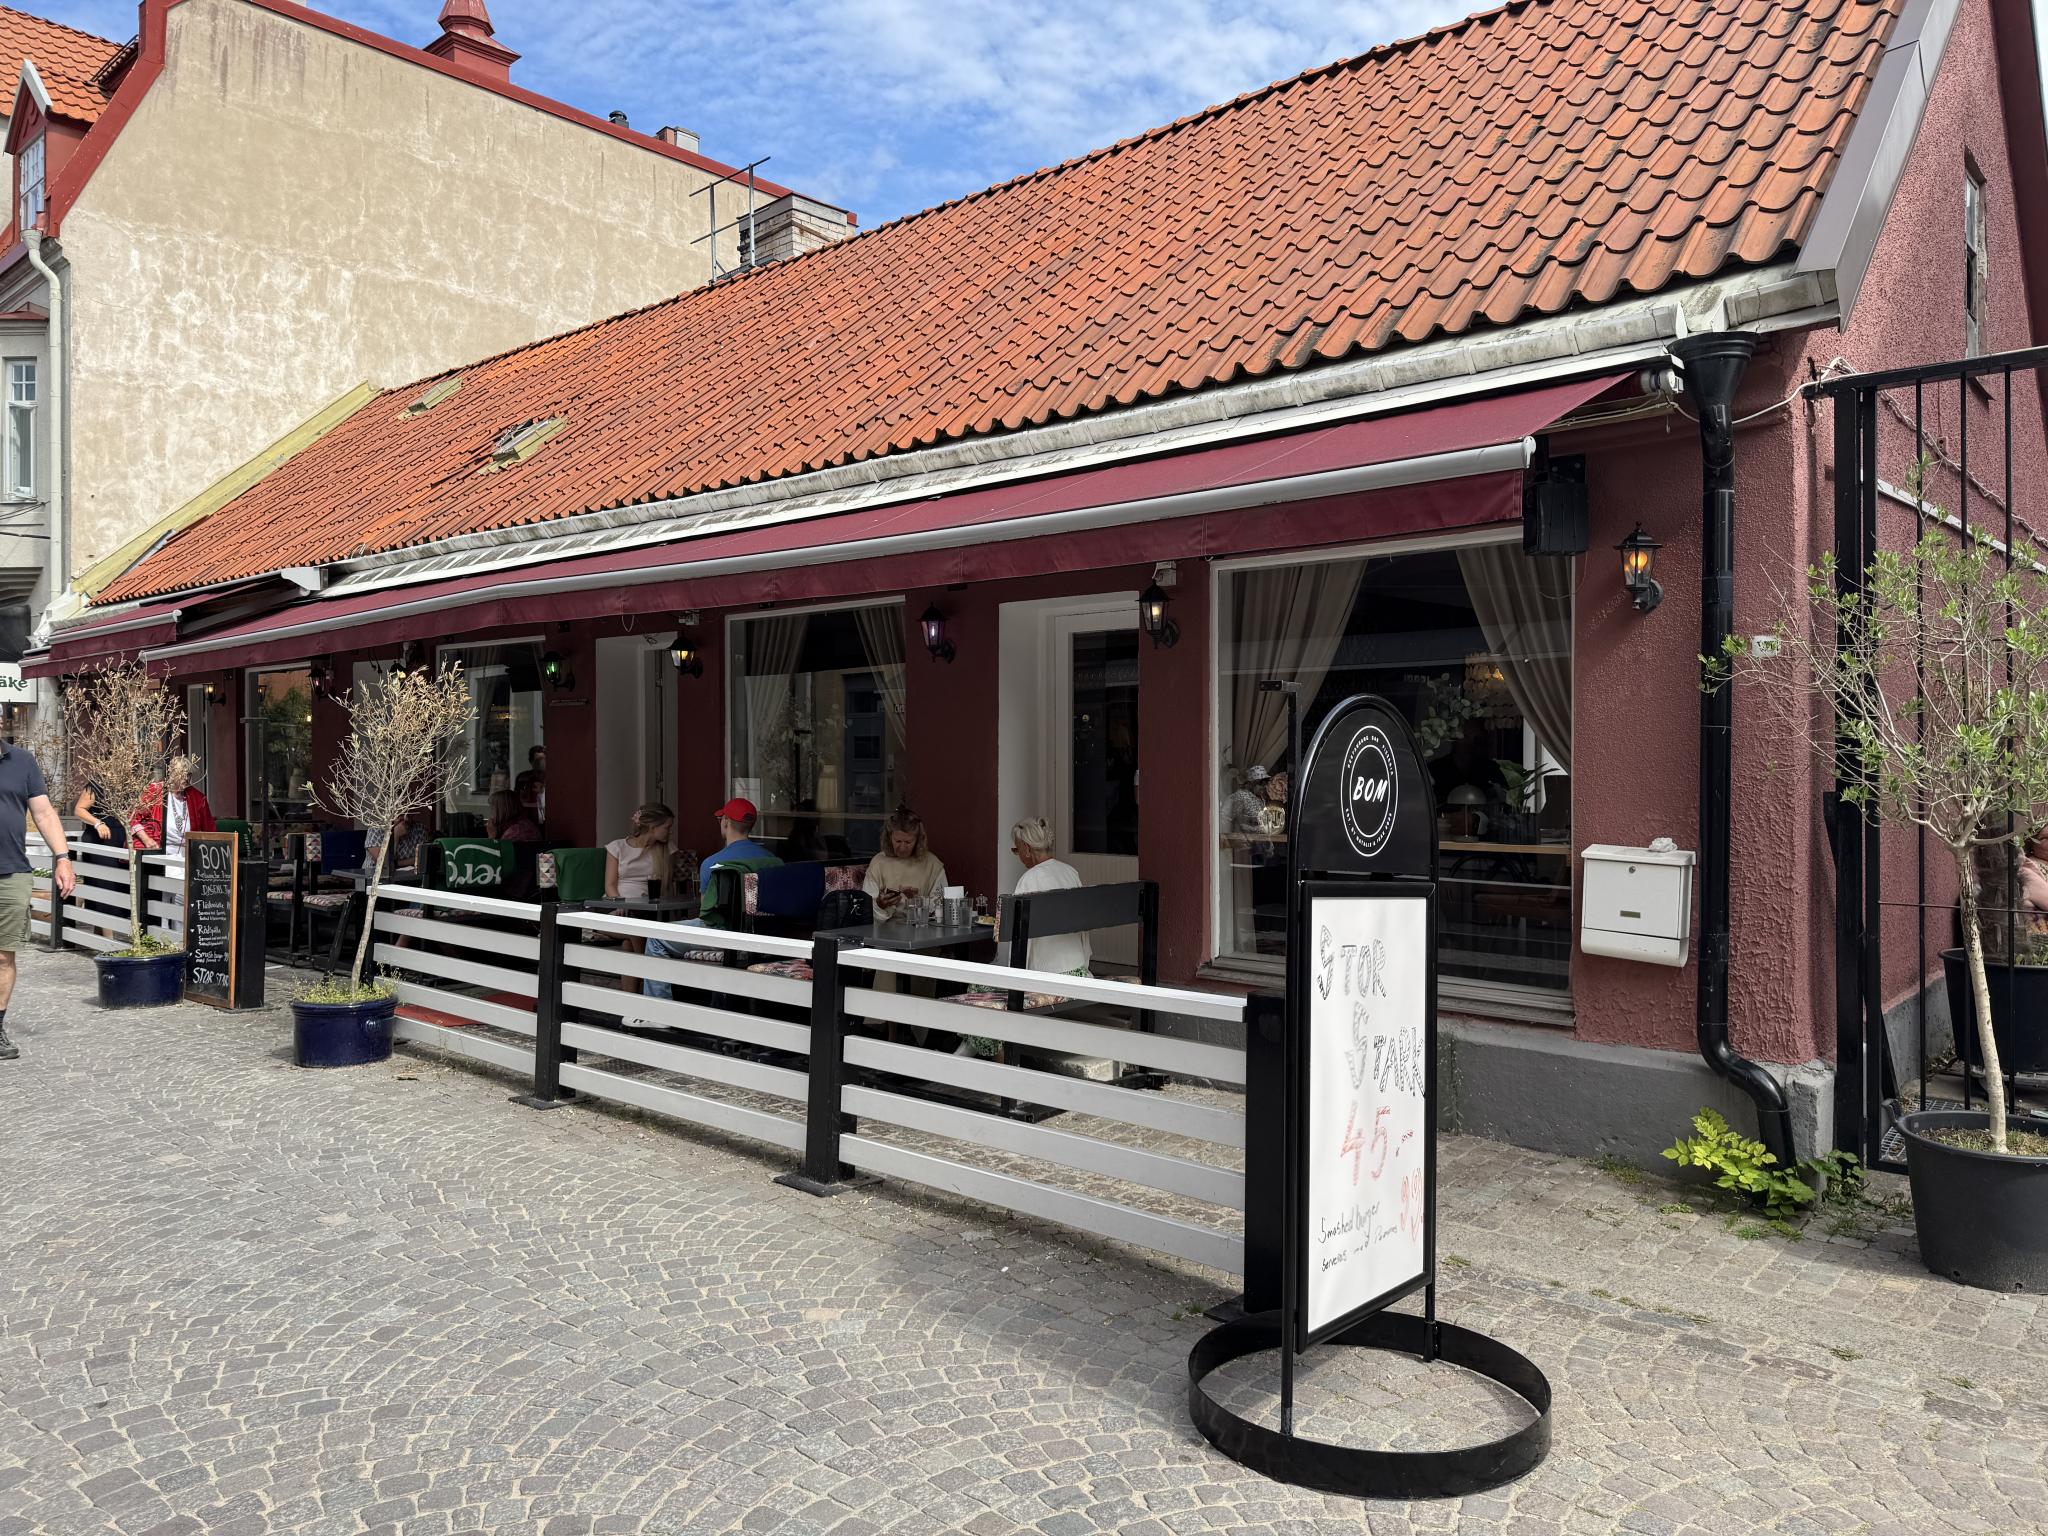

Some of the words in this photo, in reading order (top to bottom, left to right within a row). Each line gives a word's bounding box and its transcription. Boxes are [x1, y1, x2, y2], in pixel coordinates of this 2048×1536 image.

[1352, 776, 1388, 803] BOM
[198, 843, 232, 870] BOM
[1317, 924, 1387, 1001] STOR
[1344, 1000, 1425, 1100] STARK
